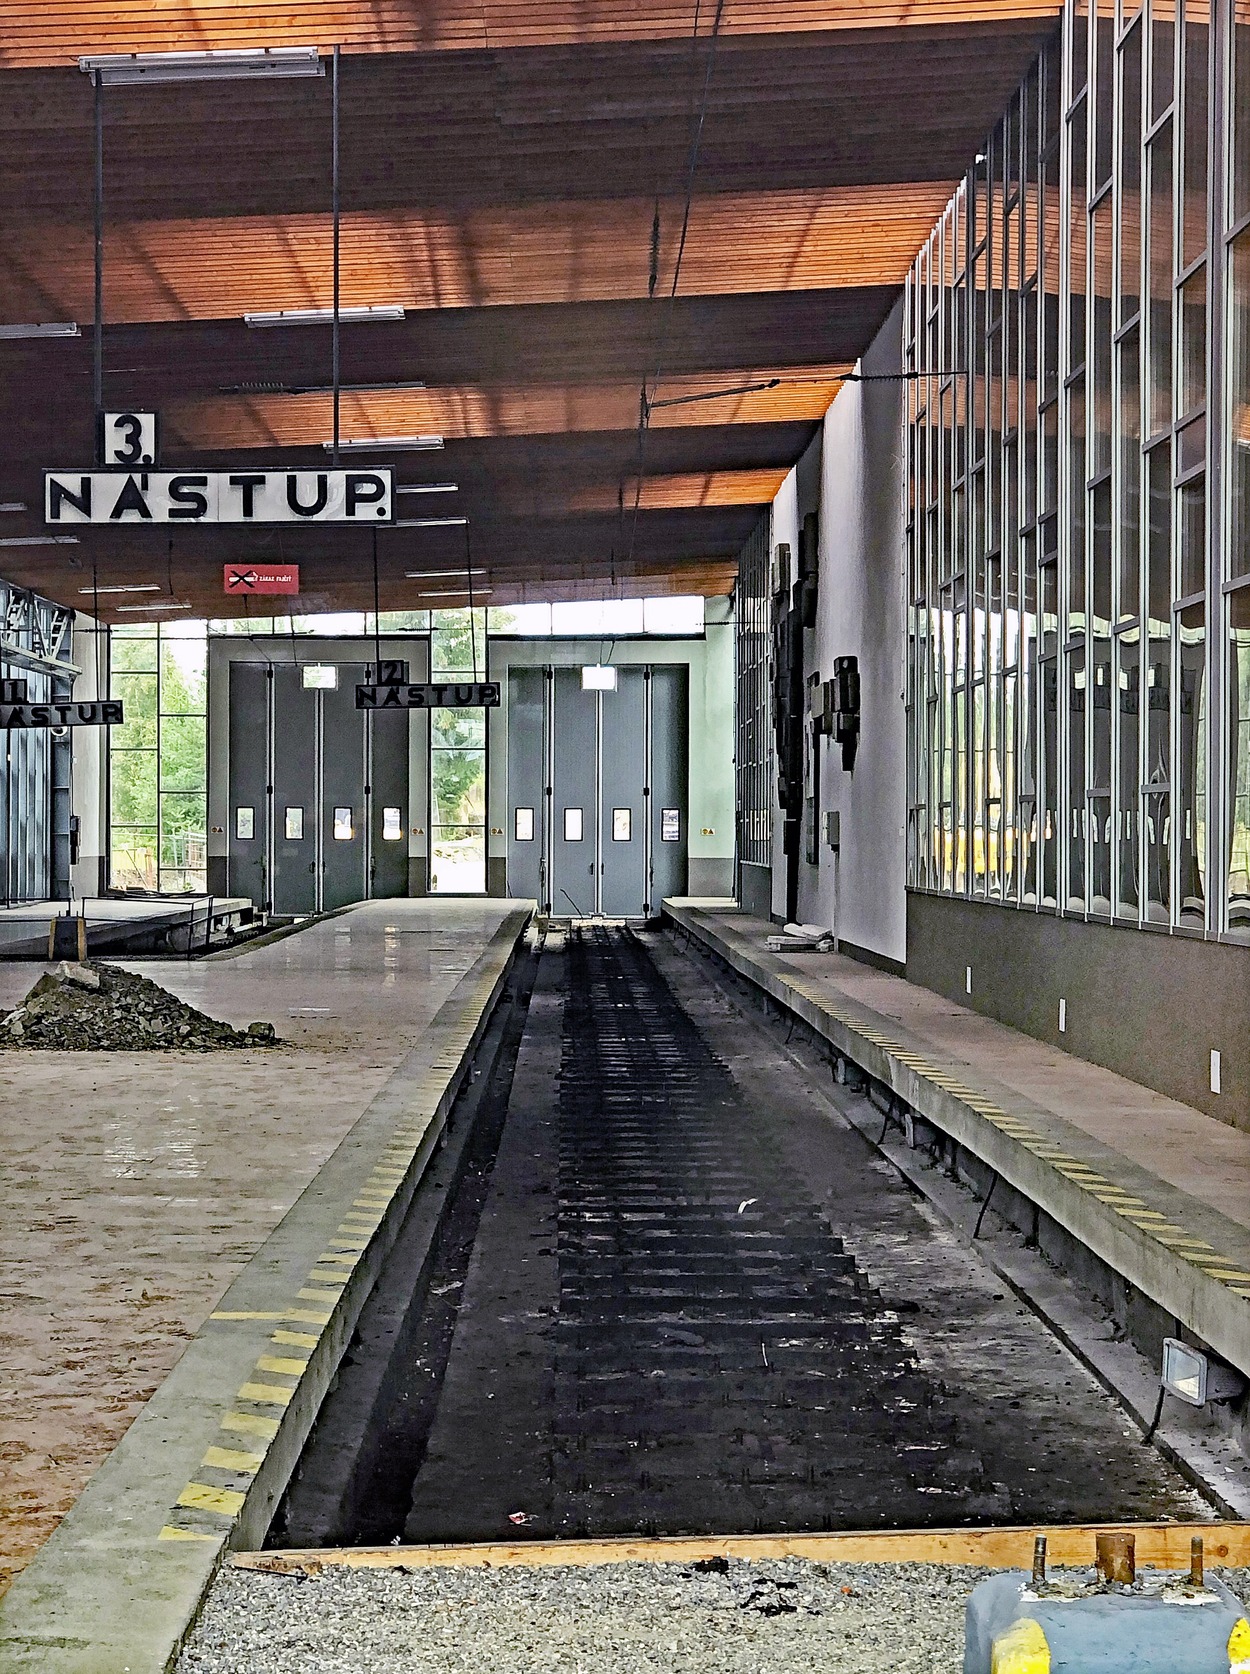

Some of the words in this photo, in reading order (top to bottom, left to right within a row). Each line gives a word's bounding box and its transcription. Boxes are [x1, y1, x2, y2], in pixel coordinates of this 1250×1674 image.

[114, 414, 152, 463] 3.
[50, 473, 386, 519] NÁSTUP.
[0, 704, 120, 726] ÁSTUP.
